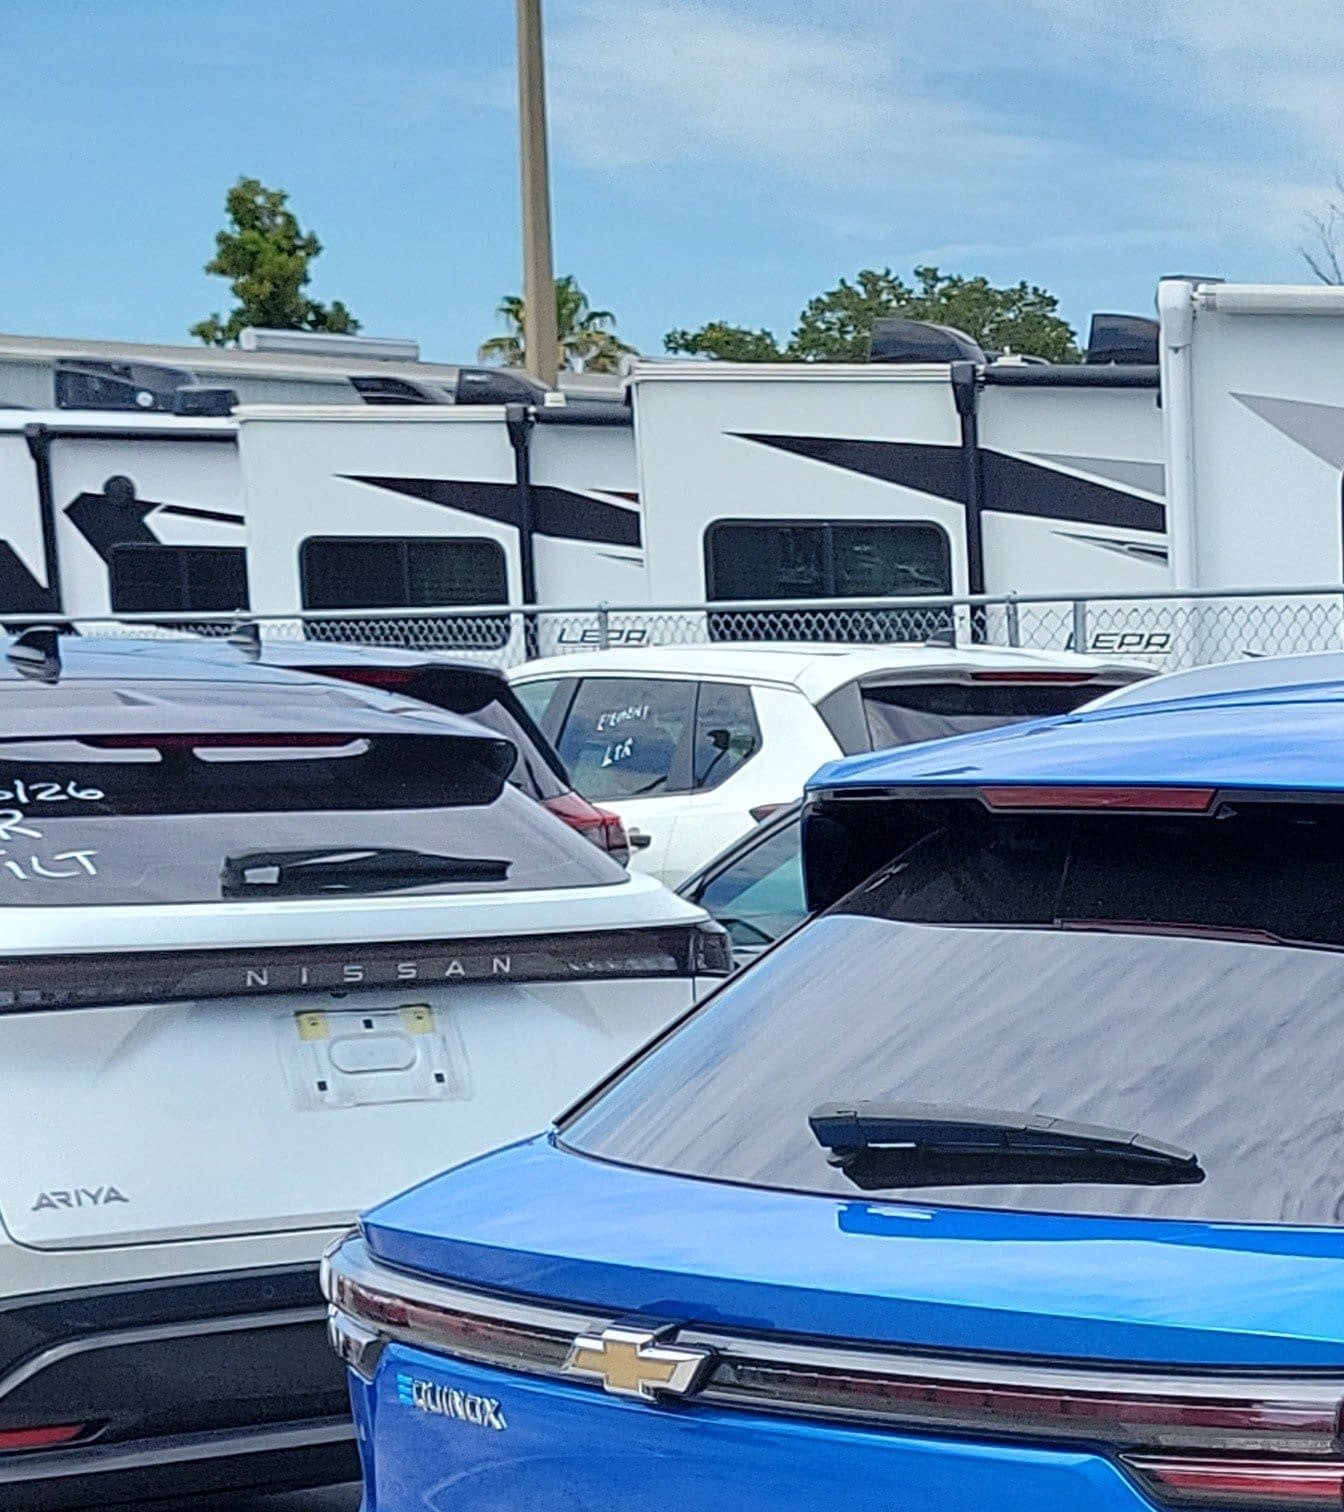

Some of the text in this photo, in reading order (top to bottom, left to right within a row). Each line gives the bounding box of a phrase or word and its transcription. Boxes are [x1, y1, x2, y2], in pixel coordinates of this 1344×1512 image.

[246, 956, 512, 987] NISSAN
[31, 1186, 130, 1211] ARIYA
[397, 1374, 508, 1430] EQUINOX
